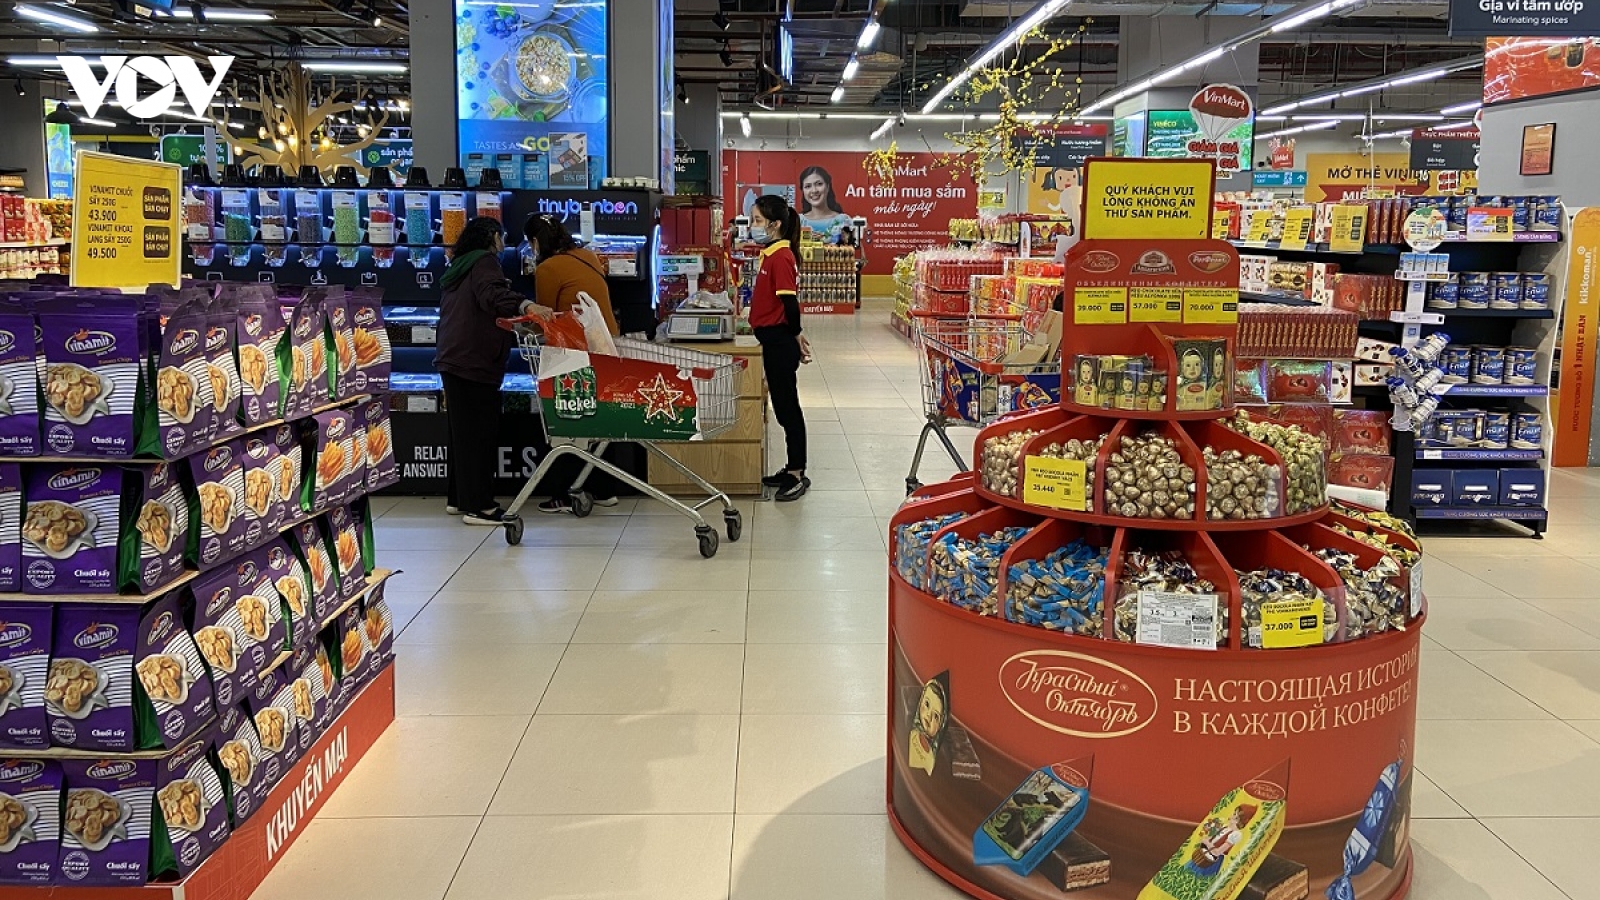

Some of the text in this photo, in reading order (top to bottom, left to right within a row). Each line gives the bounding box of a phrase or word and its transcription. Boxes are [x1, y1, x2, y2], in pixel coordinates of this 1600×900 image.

[1492, 15, 1569, 26] Marinating spices
[1204, 90, 1246, 111] VinMart
[474, 141, 508, 151] TASTES
[1328, 164, 1353, 180] MỞ
[1355, 164, 1381, 179] THẺ
[90, 185, 115, 195] VINAMIT
[845, 182, 967, 198] An tâm mua sắm
[1105, 182, 1195, 196] QUÝ KHÁCH VUI
[1103, 195, 1196, 208] LÒNG KHÔNG ĂN
[88, 209, 117, 221] 43.900
[1104, 206, 1192, 219] THỬ SẢN PHẨM.
[114, 225, 133, 233] KHOAI
[88, 235, 104, 244] LANG
[87, 247, 117, 259] 49.500
[1579, 251, 1593, 305] kikkoman
[1016, 659, 1119, 697] Красный
[1173, 671, 1352, 703] НАСТОЯЩАЯ
[1046, 689, 1139, 732] Октябрь
[1173, 678, 1412, 739] В КАЖДОЙ КОНФЕТЕ!
[266, 726, 348, 861] KHUYẾN MẠI
